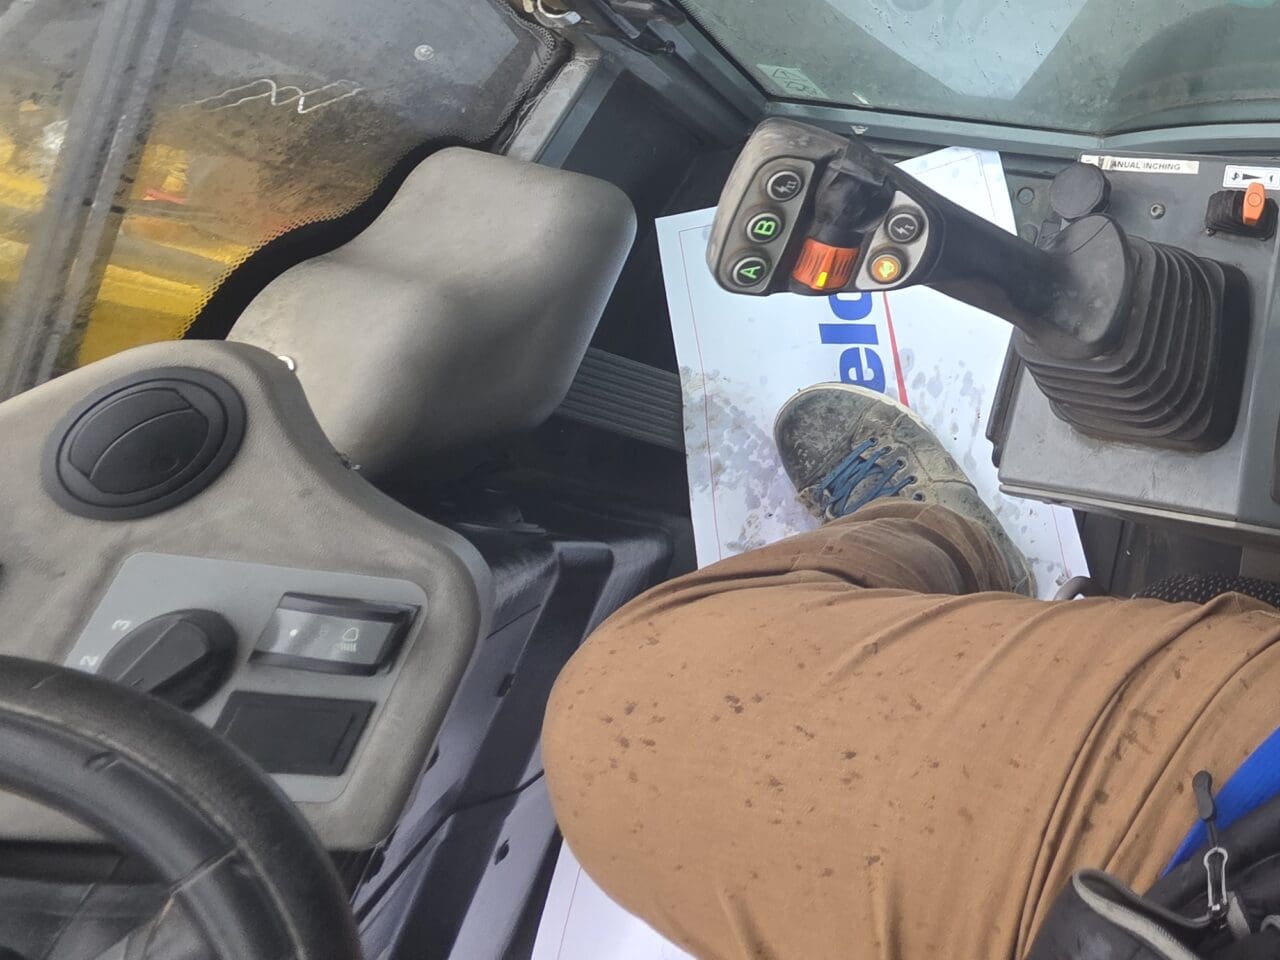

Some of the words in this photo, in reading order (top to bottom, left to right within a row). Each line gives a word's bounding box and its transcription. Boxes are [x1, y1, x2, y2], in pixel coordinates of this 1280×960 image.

[1110, 160, 1140, 169] ANUAL
[1143, 161, 1181, 170] INCHING
[753, 219, 776, 236] B
[739, 265, 761, 279] A
[111, 619, 131, 630] 3
[79, 655, 98, 666] 2
